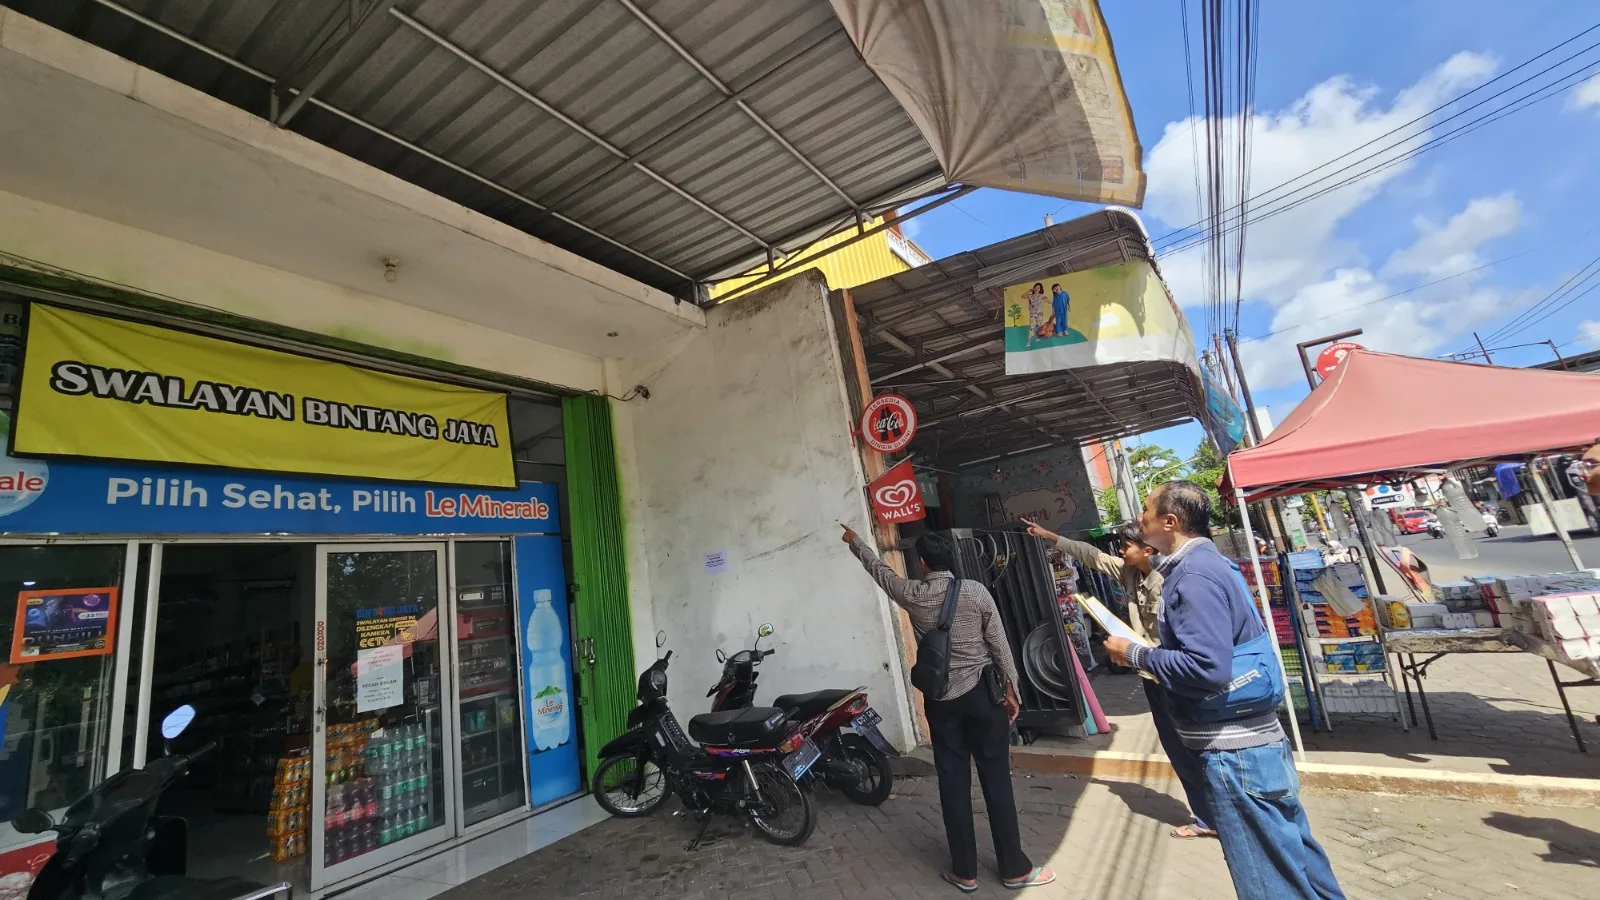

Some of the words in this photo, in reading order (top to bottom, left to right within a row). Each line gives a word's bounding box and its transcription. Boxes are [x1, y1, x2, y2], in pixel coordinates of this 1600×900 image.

[51, 361, 295, 420] SWALAYAN
[303, 398, 438, 439] BINTANG
[443, 418, 498, 448] JAYA
[869, 397, 900, 412] TERSEDIA
[870, 439, 893, 450] DINGIN
[901, 430, 912, 443] SINI
[107, 476, 208, 508] Pilih
[222, 483, 342, 514] Sehat,
[352, 489, 416, 514] Pilih
[425, 490, 456, 517] Le
[459, 494, 550, 520] Minerale
[882, 504, 920, 520] WALL'S
[356, 624, 394, 632] DILENGKAPI
[360, 630, 390, 638] KAMERA
[317, 621, 325, 651] DORONG
[359, 636, 391, 648] CCTV
[545, 699, 554, 707] Le
